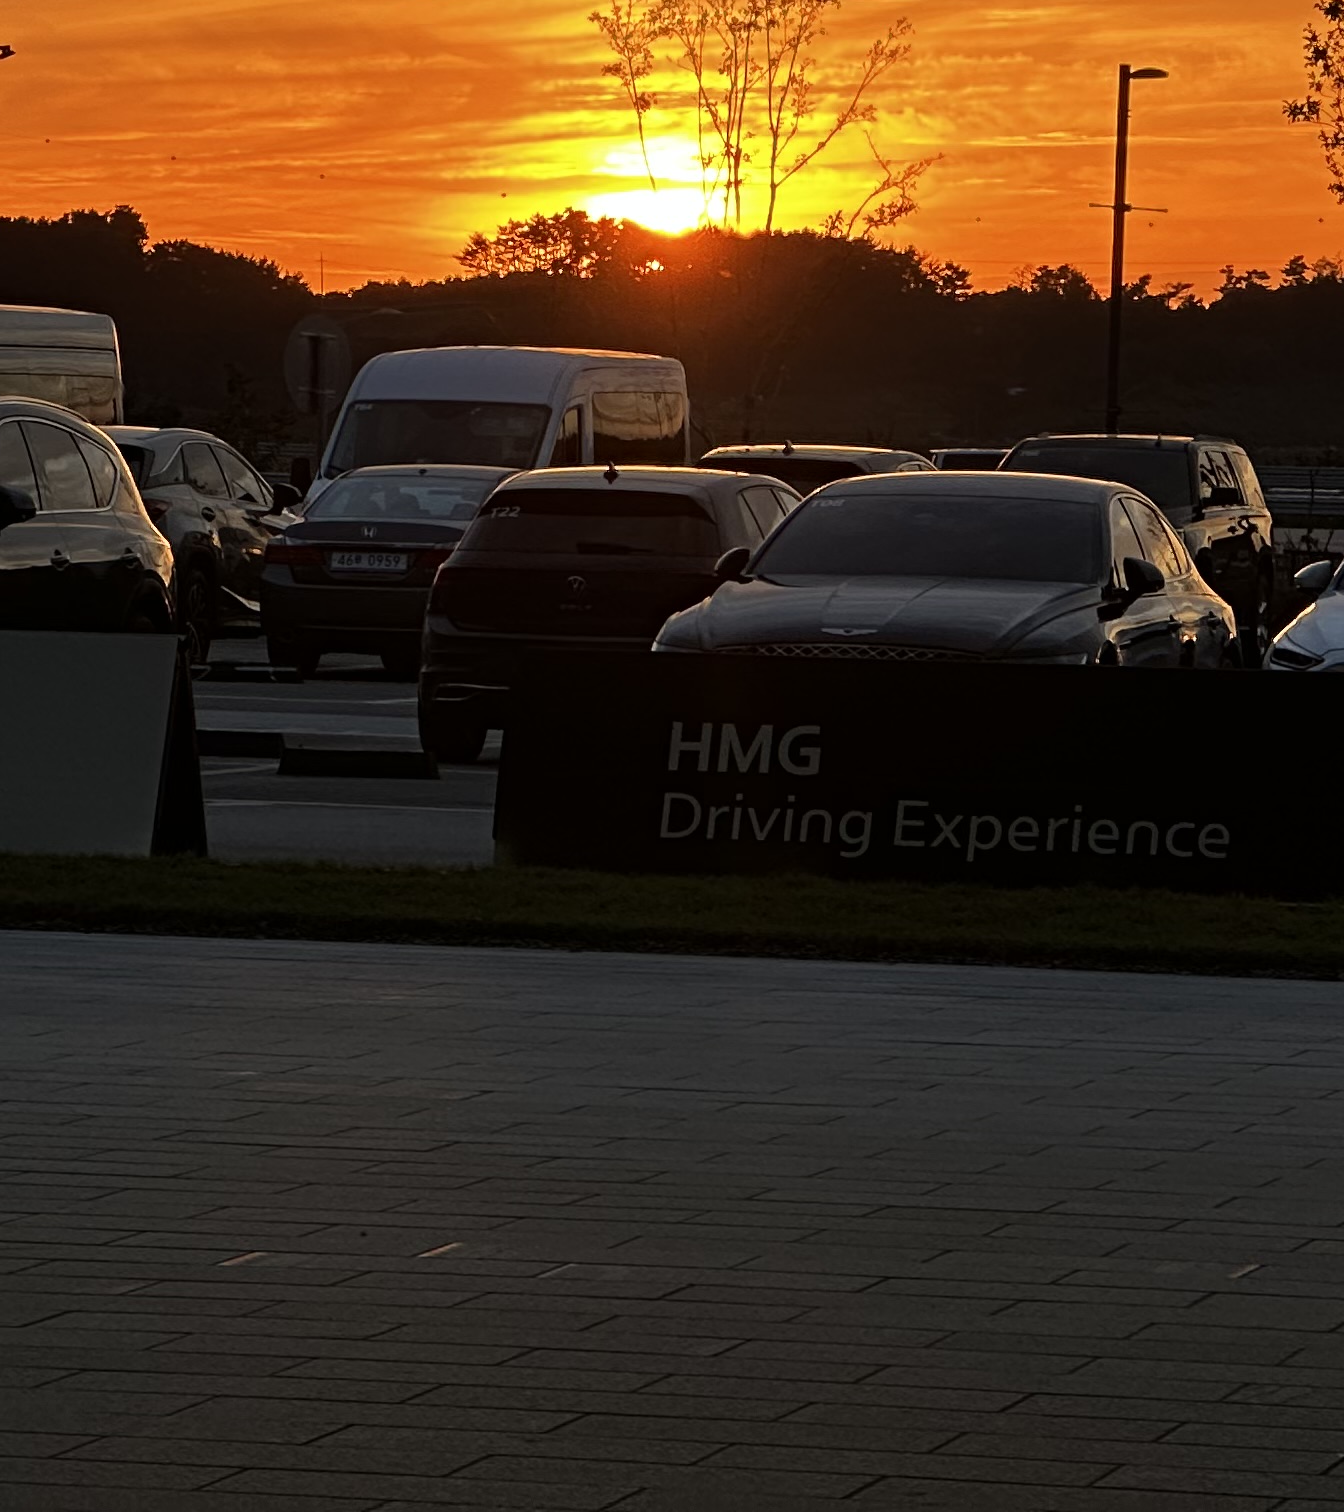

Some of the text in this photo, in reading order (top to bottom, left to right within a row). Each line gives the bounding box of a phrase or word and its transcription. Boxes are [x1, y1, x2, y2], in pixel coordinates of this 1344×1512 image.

[490, 506, 521, 518] T22
[368, 554, 401, 567] 0959
[667, 721, 823, 776] HMG
[658, 791, 1231, 862] Driving Experience
